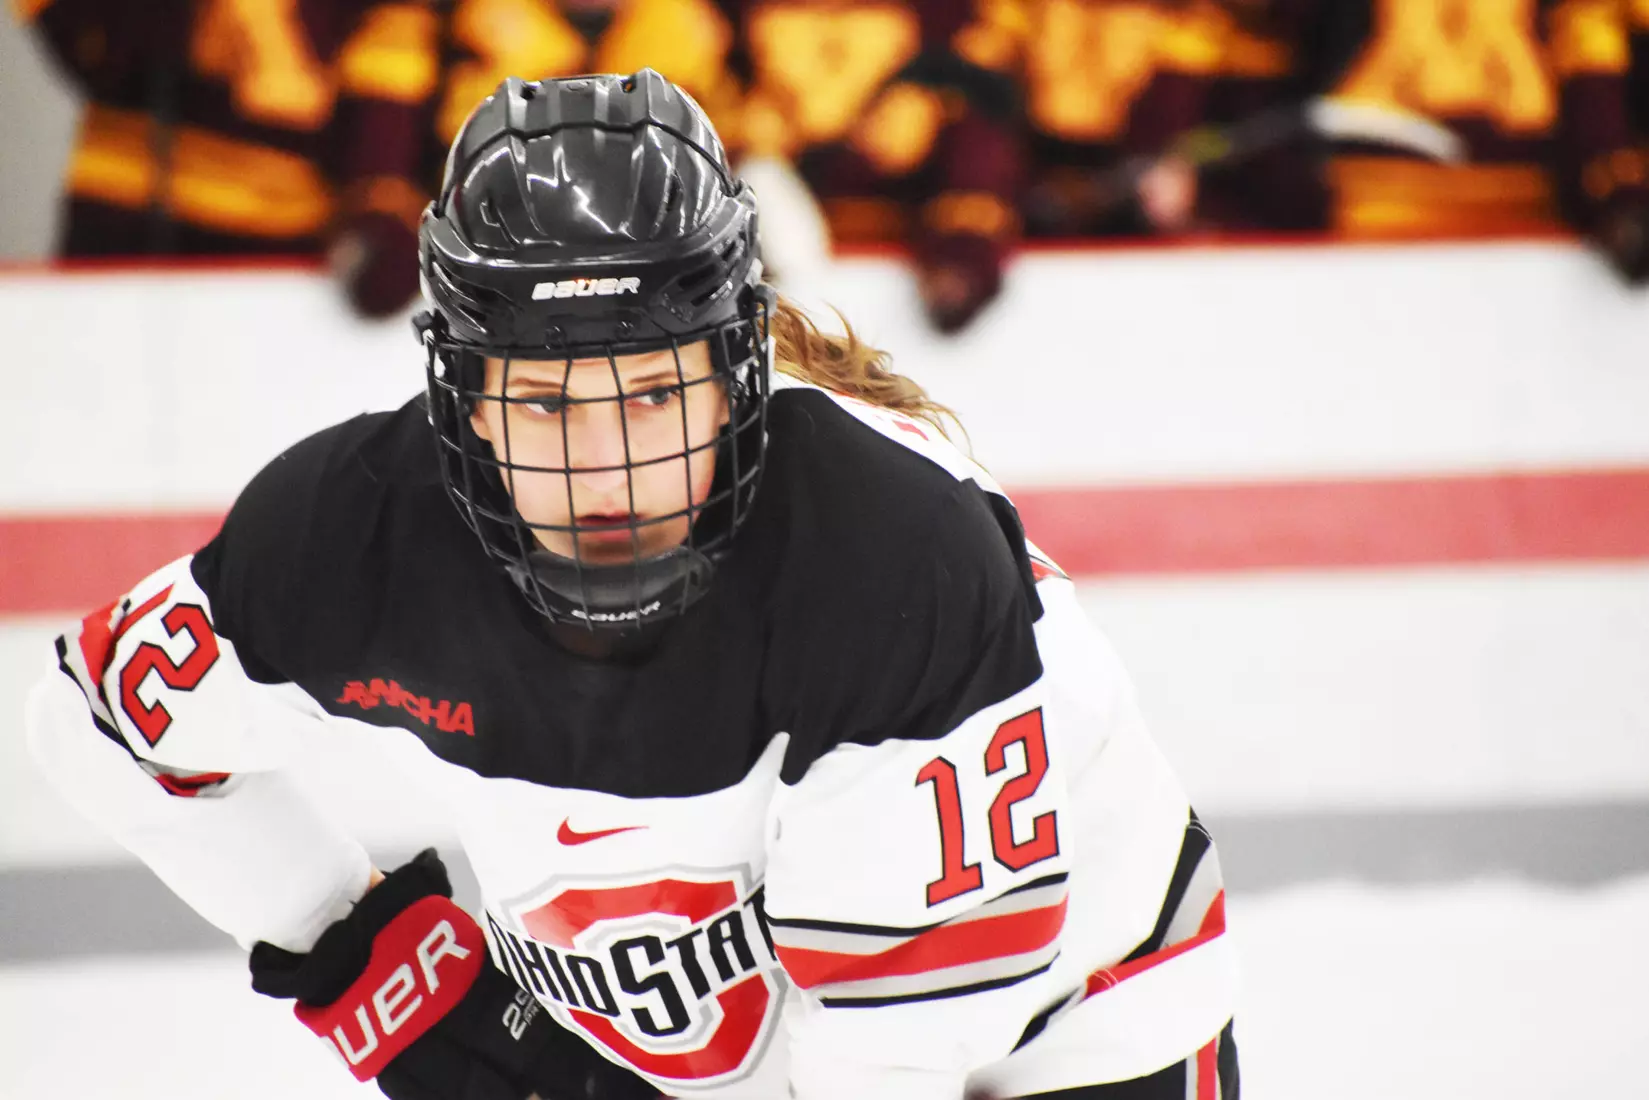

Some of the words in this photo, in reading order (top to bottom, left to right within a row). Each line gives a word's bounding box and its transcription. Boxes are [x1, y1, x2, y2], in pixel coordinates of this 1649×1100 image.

[531, 277, 641, 300] BAUER
[915, 706, 1060, 908] 12
[486, 909, 621, 1018] OHIO
